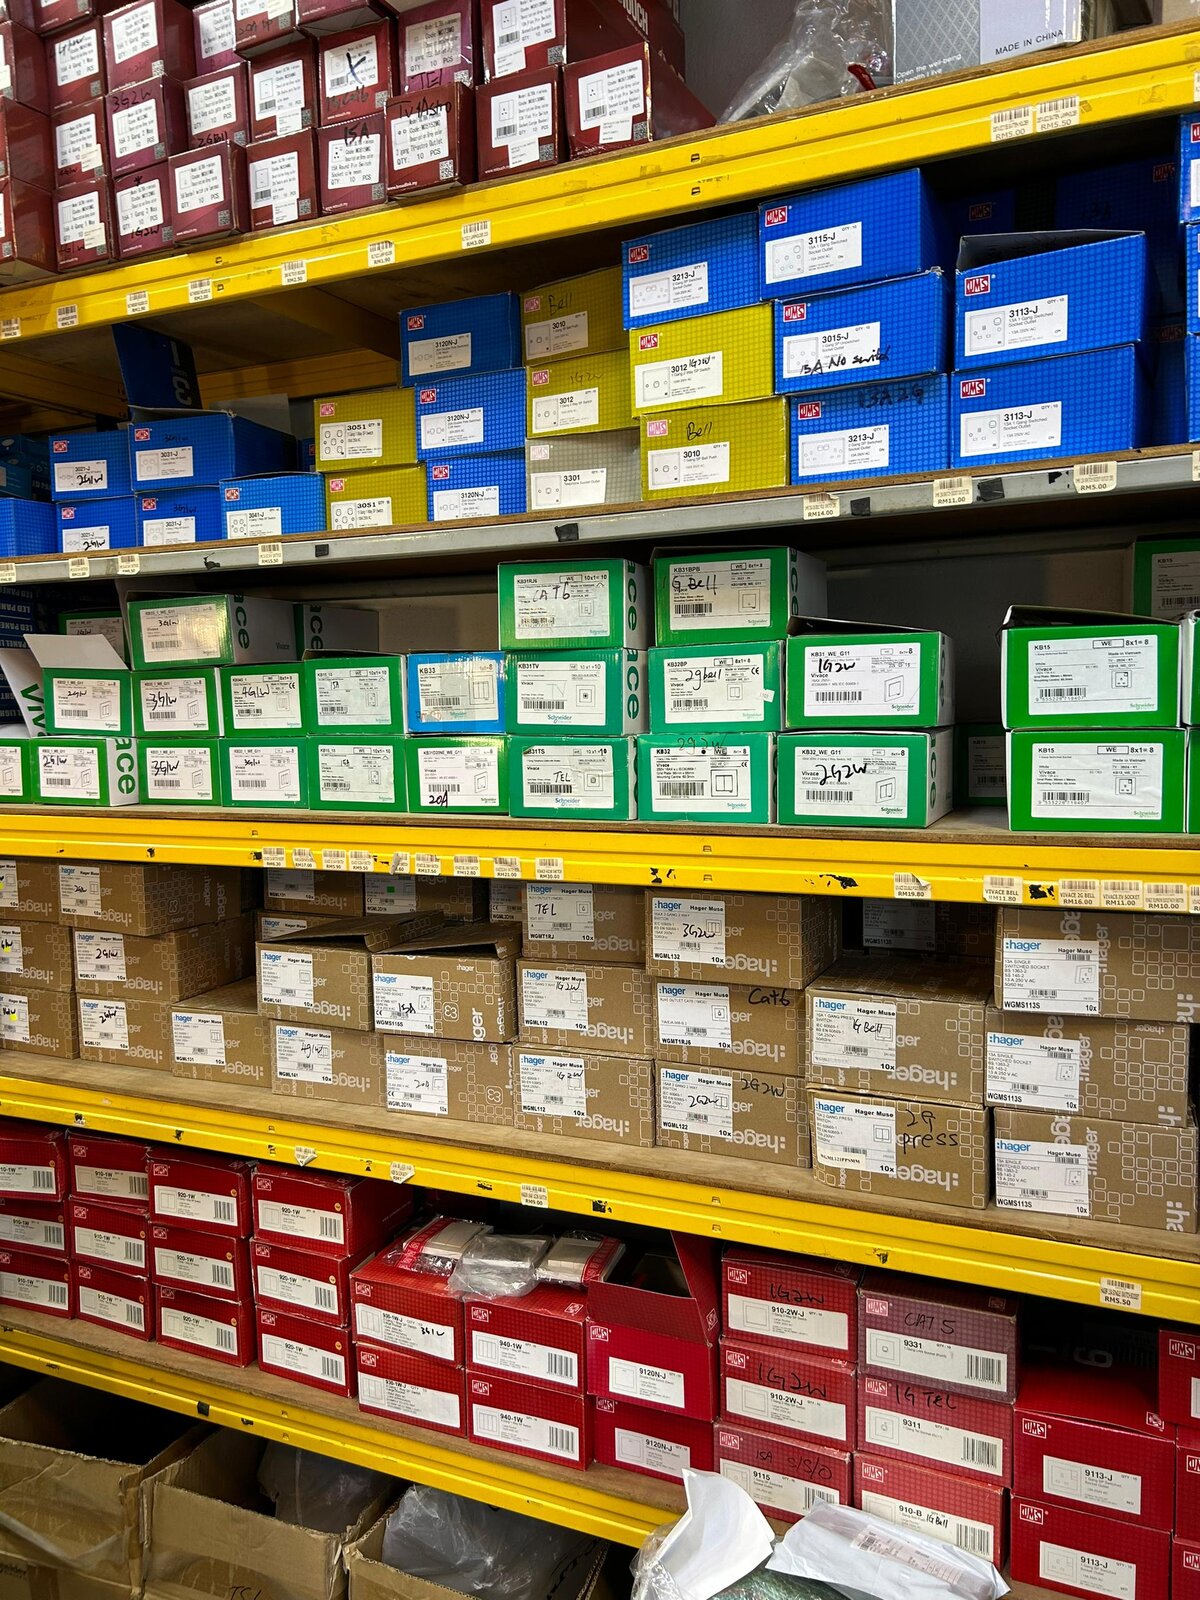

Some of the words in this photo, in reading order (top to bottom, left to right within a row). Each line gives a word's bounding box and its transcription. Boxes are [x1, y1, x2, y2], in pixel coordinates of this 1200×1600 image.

[995, 44, 1023, 56] MADE
[1024, 36, 1034, 50] IN
[1035, 29, 1064, 47] CHINA
[1040, 119, 1072, 131] RM5.50
[995, 128, 1026, 141] RM5.00
[430, 148, 441, 157] PCS
[808, 233, 836, 245] 3115-J
[672, 270, 695, 281] 3213-J
[1009, 306, 1038, 318] 3113-J
[552, 321, 566, 330] 3010
[435, 339, 457, 348] 3120N-J
[822, 333, 848, 344] 3015-J
[671, 363, 688, 373] 3012
[559, 396, 574, 404] 3012
[447, 414, 470, 423] 3120N-J
[1004, 411, 1032, 422] 3113-J
[687, 421, 712, 440] Bell
[848, 433, 874, 443] 3213-J
[683, 450, 700, 459] 3010
[563, 474, 580, 482] 3301
[1080, 483, 1107, 491] RM5.00
[460, 490, 484, 499] 3120N-J
[937, 496, 966, 504] RM11.00
[807, 509, 833, 517] RM14.00
[419, 667, 436, 675] KB33
[1130, 702, 1155, 710] Schneider
[1005, 1001, 1040, 1009] WGMS113S
[857, 1007, 876, 1016] Hager
[525, 1019, 548, 1027] WGML112
[880, 1063, 895, 1071] 10x
[987, 1092, 1023, 1103] WGMS113S
[522, 1105, 546, 1113] WGML112
[1066, 1101, 1077, 1109] 10x
[855, 1108, 874, 1117] Hager
[875, 1110, 894, 1118] Muse
[663, 1122, 688, 1130] WGML122
[880, 1165, 895, 1173] 10x
[997, 1198, 1032, 1209] WGMS113S
[282, 1207, 301, 1216] 920-1W
[1076, 1206, 1088, 1214] 10x
[279, 1274, 297, 1283] 920-1W
[1104, 1296, 1131, 1306] RM5.50
[772, 1306, 805, 1317] 910-2W-J
[941, 1320, 956, 1334] 5
[285, 1343, 303, 1353] 920-1W
[499, 1340, 522, 1350] 940-1W
[904, 1339, 922, 1349] 9331
[639, 1368, 666, 1379] 9120N-J
[770, 1392, 803, 1406] 910-2W-J
[500, 1413, 523, 1423] 940-1W
[902, 1418, 921, 1429] 9311
[646, 1439, 673, 1451] 9120N-J
[753, 1470, 771, 1480] 9115
[1085, 1469, 1113, 1481] 9113-J
[898, 1504, 922, 1517] 910-B
[1080, 1557, 1108, 1568] 9113-J
